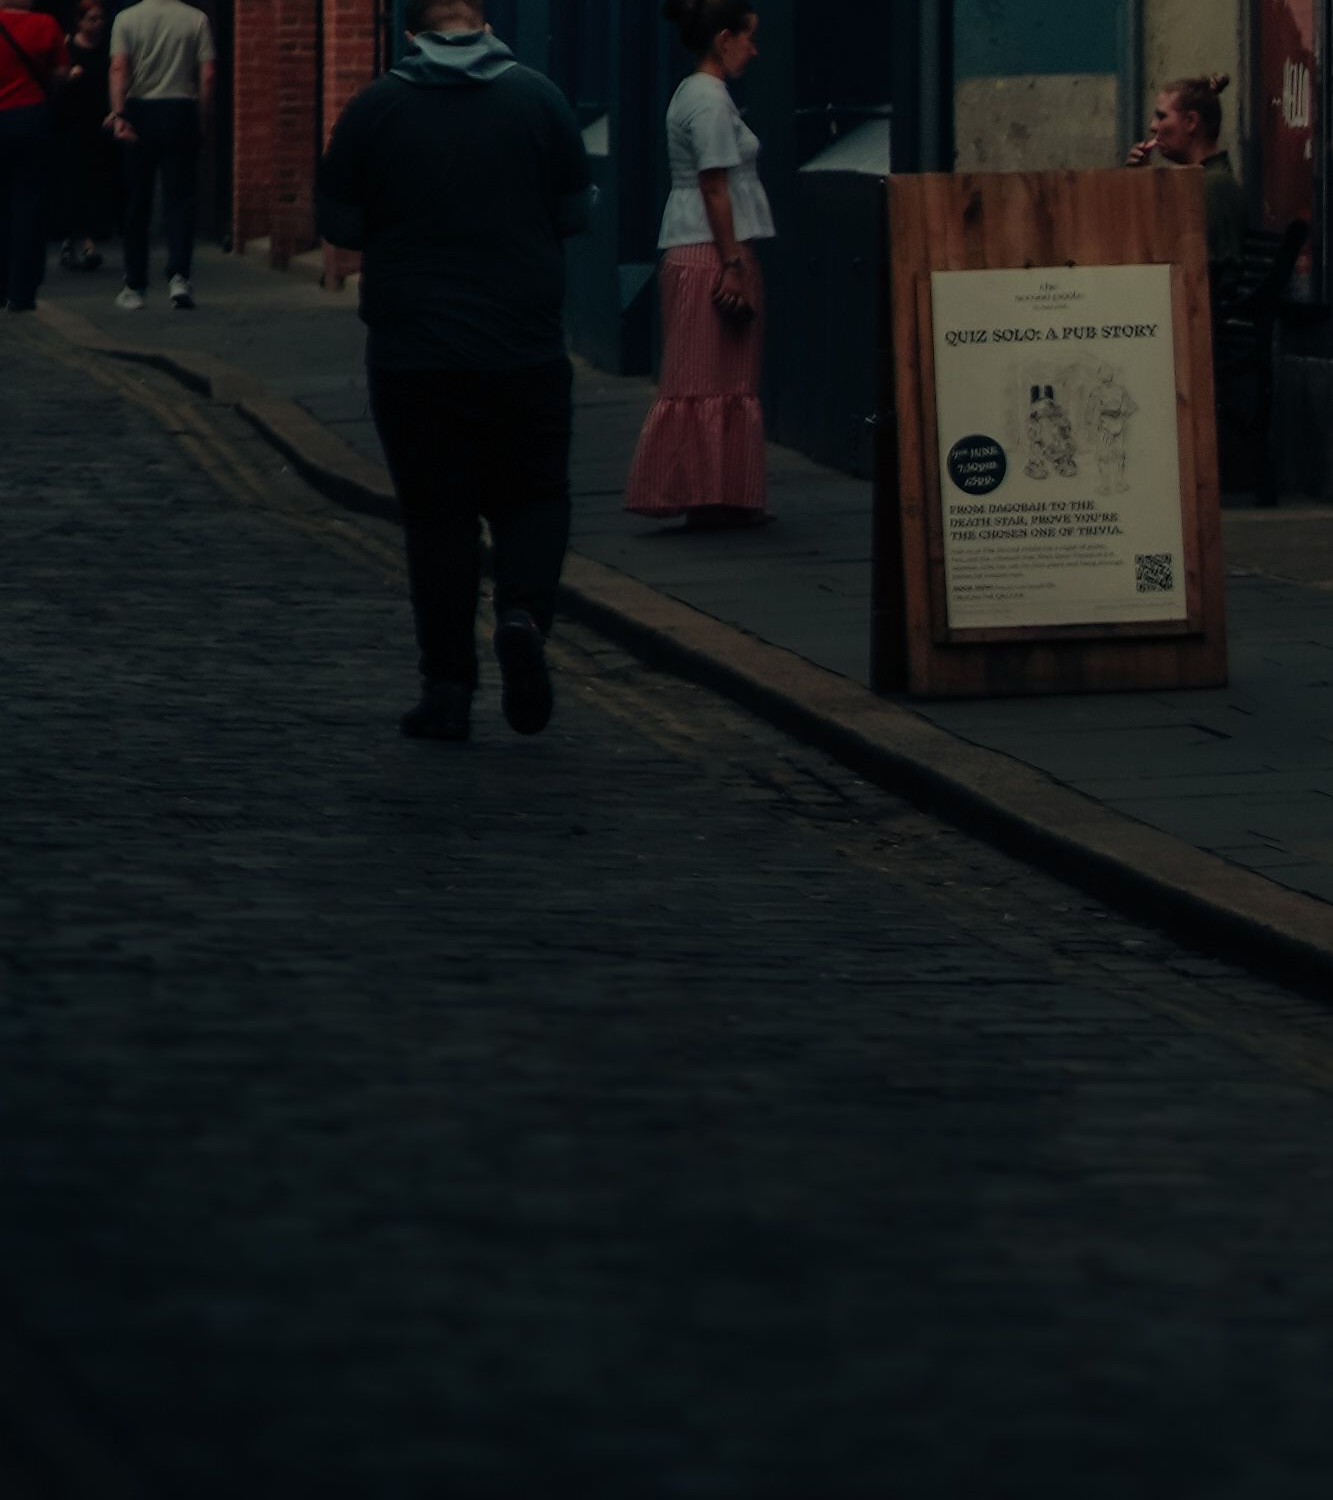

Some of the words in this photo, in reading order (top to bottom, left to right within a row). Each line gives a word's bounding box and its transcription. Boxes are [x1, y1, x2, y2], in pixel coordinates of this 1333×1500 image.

[945, 330, 987, 347] QUIZ
[992, 327, 1041, 343] SOLO:
[1045, 327, 1058, 340] A
[1062, 326, 1097, 339] PUB
[1101, 324, 1159, 339] STORY
[949, 504, 985, 514] FROM
[989, 502, 1046, 513] DAGOBAH
[1049, 501, 1065, 511] TO
[1070, 500, 1096, 510] THE
[949, 516, 990, 527] DEATH
[1031, 513, 1071, 525] PROVE
[1075, 512, 1119, 523] YOU'RE
[951, 530, 975, 540] THE
[979, 529, 1027, 540] CHOSEN
[1030, 527, 1056, 538] ONE
[1059, 527, 1074, 537] OF
[1078, 525, 1123, 536] TRIVIA.
